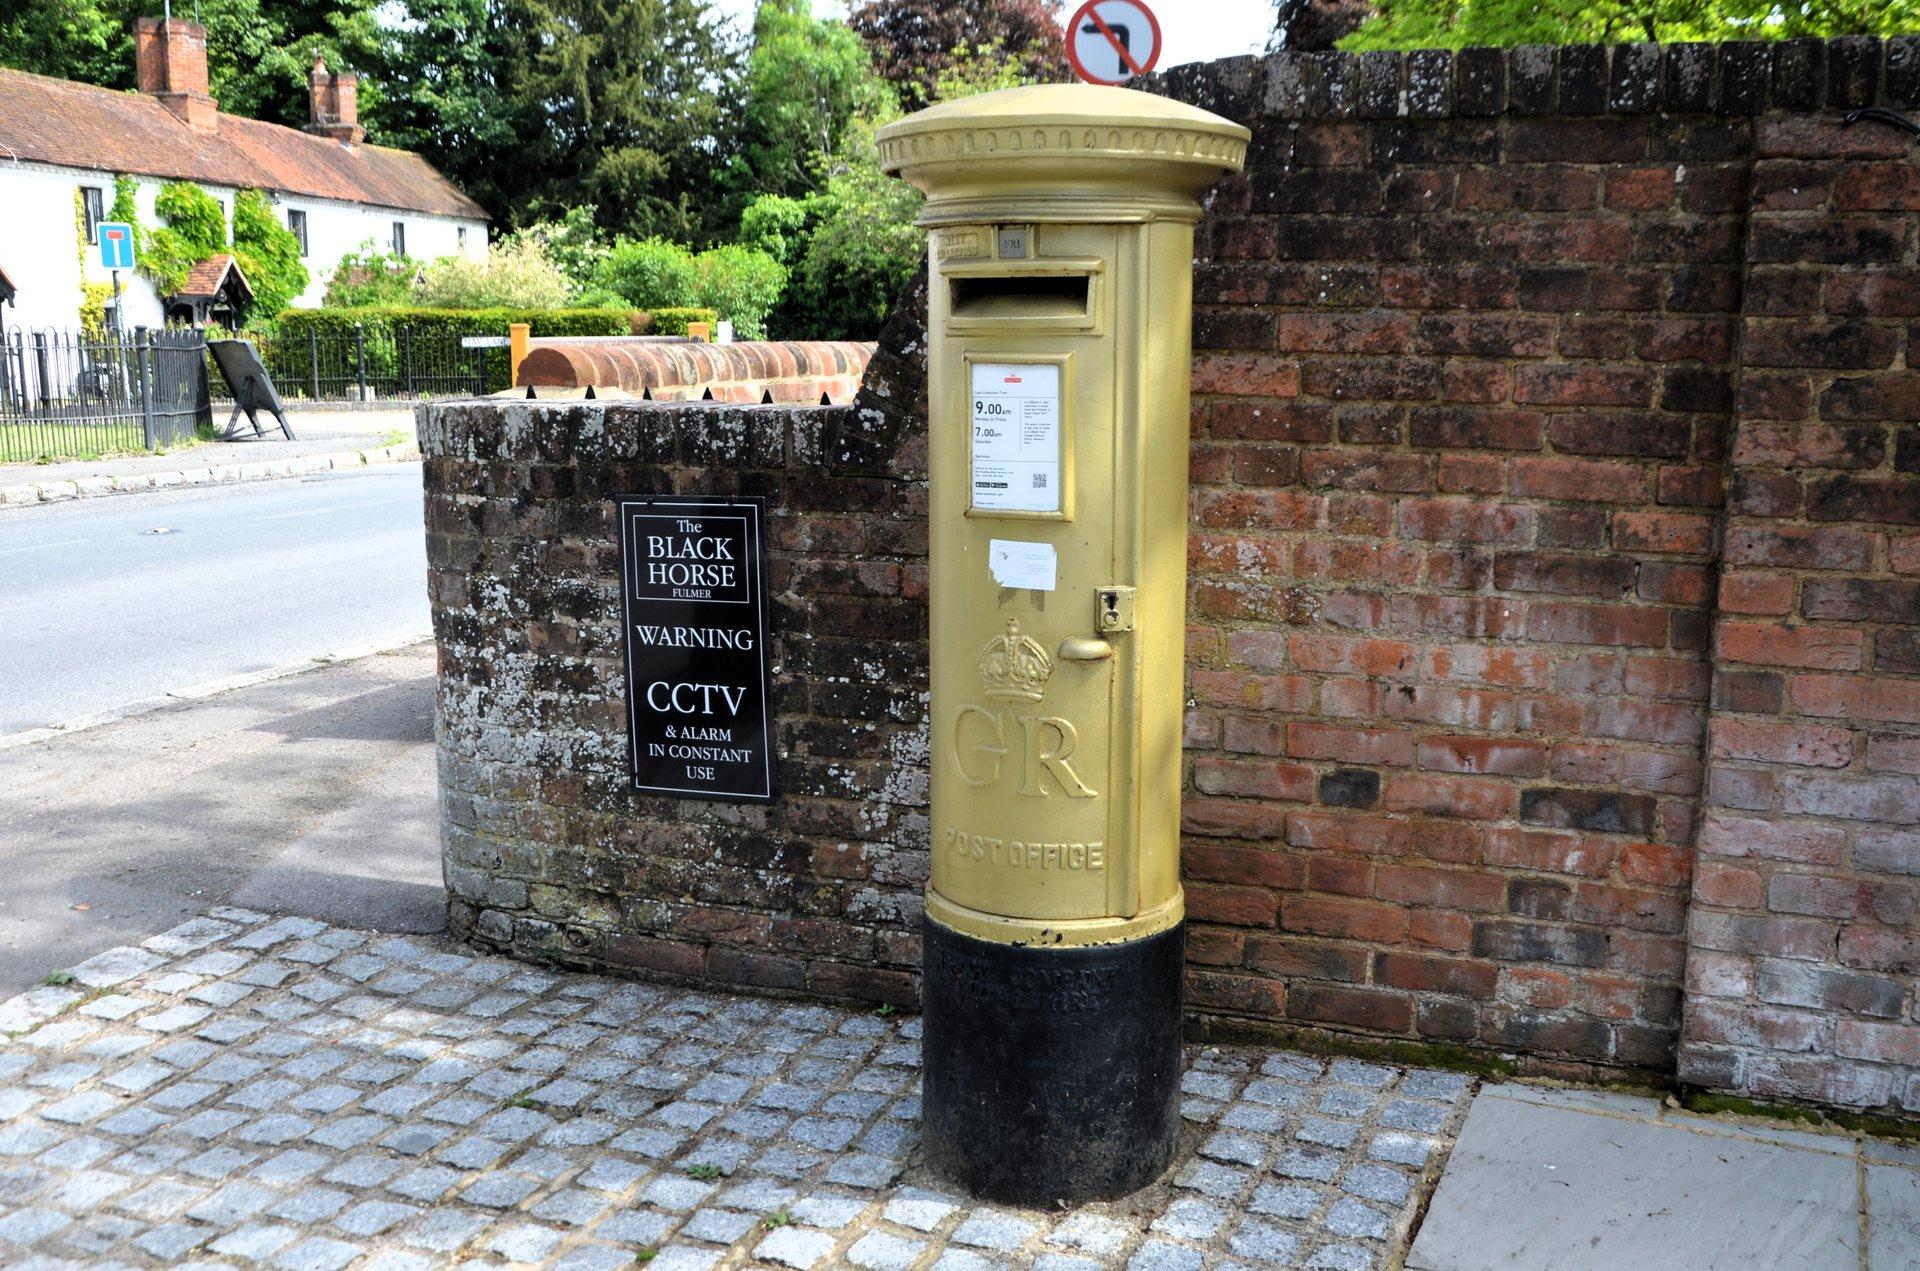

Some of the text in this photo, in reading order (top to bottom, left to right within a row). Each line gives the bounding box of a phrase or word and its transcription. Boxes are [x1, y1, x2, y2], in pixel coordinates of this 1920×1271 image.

[975, 401, 1012, 415] 9.00am
[975, 427, 1003, 437] 7.00am
[677, 519, 702, 533] The
[646, 536, 735, 561] BLACK
[647, 563, 736, 587] HORSE
[672, 588, 712, 599] FULMER
[636, 624, 753, 651] WARNING
[646, 680, 748, 717] CCTV
[665, 724, 732, 742] & ALARM
[648, 744, 752, 763] IN CONSTANT
[685, 765, 715, 780] USE
[944, 827, 1104, 871] POST OFFICE
